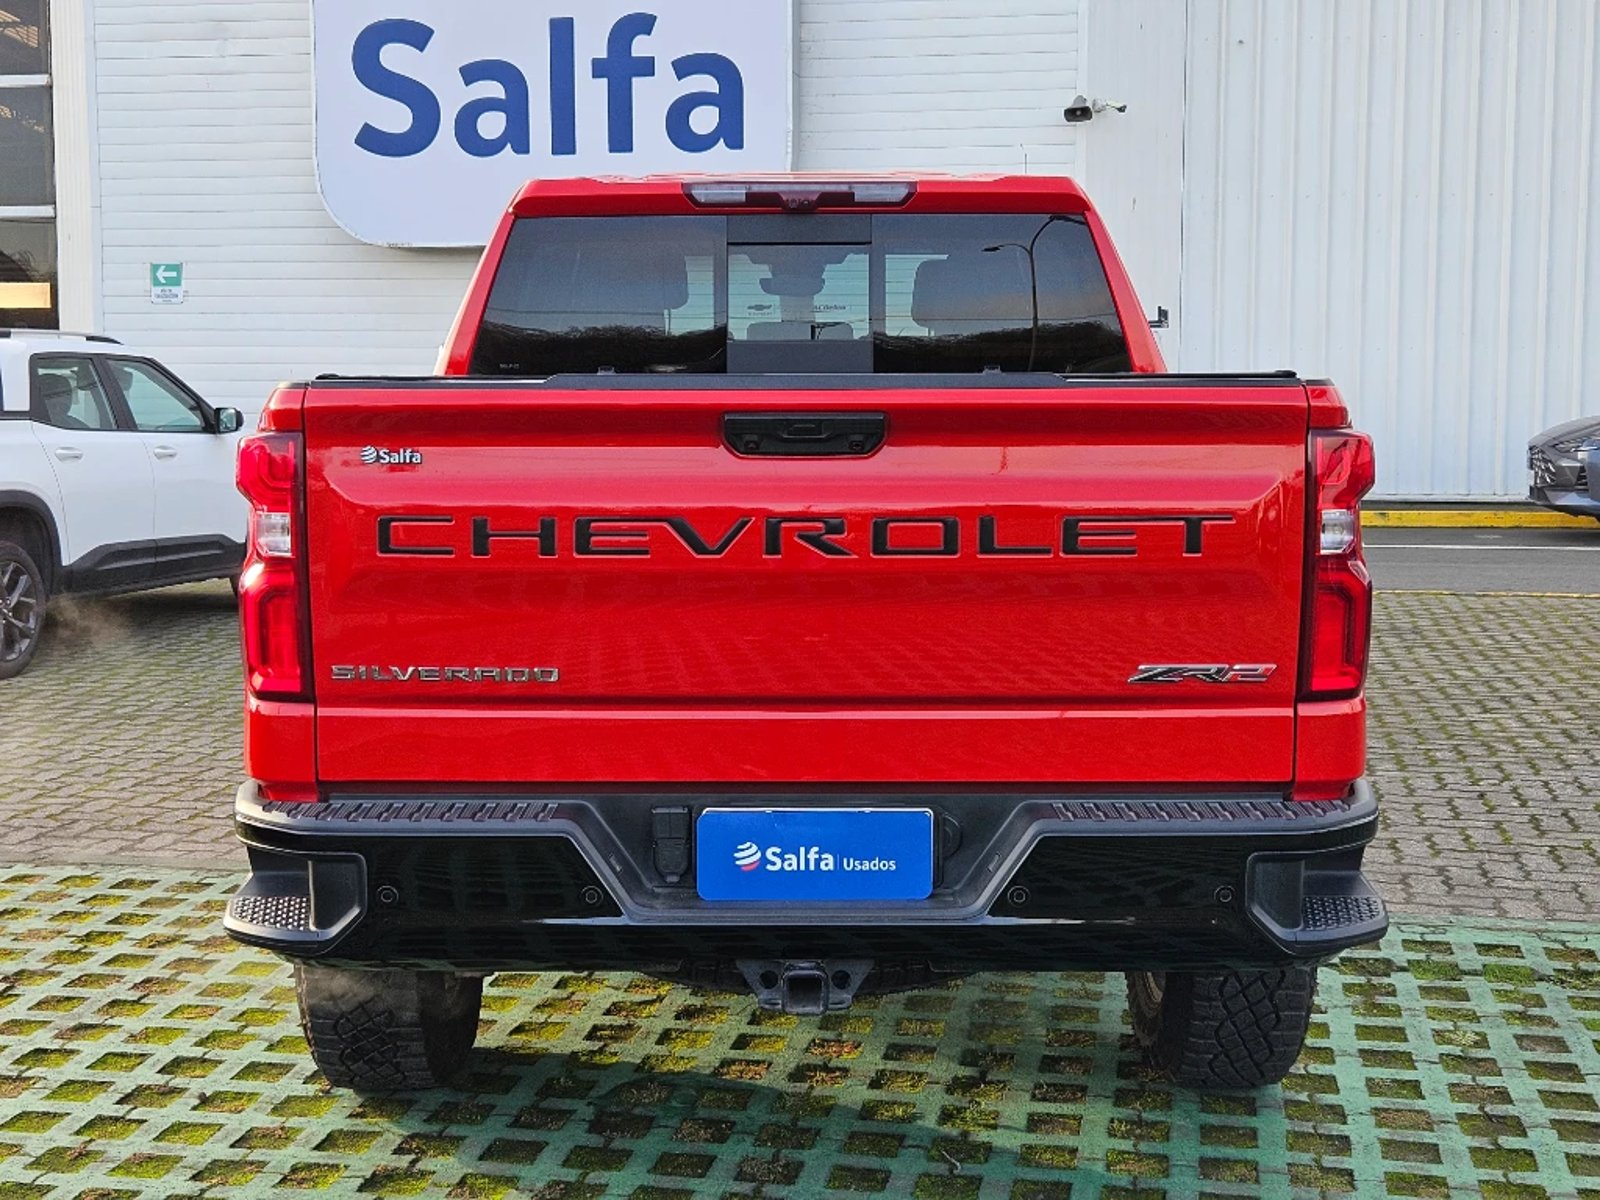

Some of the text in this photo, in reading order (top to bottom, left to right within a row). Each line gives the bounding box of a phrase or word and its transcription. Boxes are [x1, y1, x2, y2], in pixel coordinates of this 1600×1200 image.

[351, 12, 745, 158] Salfa
[379, 447, 422, 464] Salfa
[376, 514, 1236, 559] CHEVROLET
[330, 664, 560, 683] SILVERADO
[1127, 663, 1278, 684] ZR2
[765, 846, 897, 872] Salfa Usados
